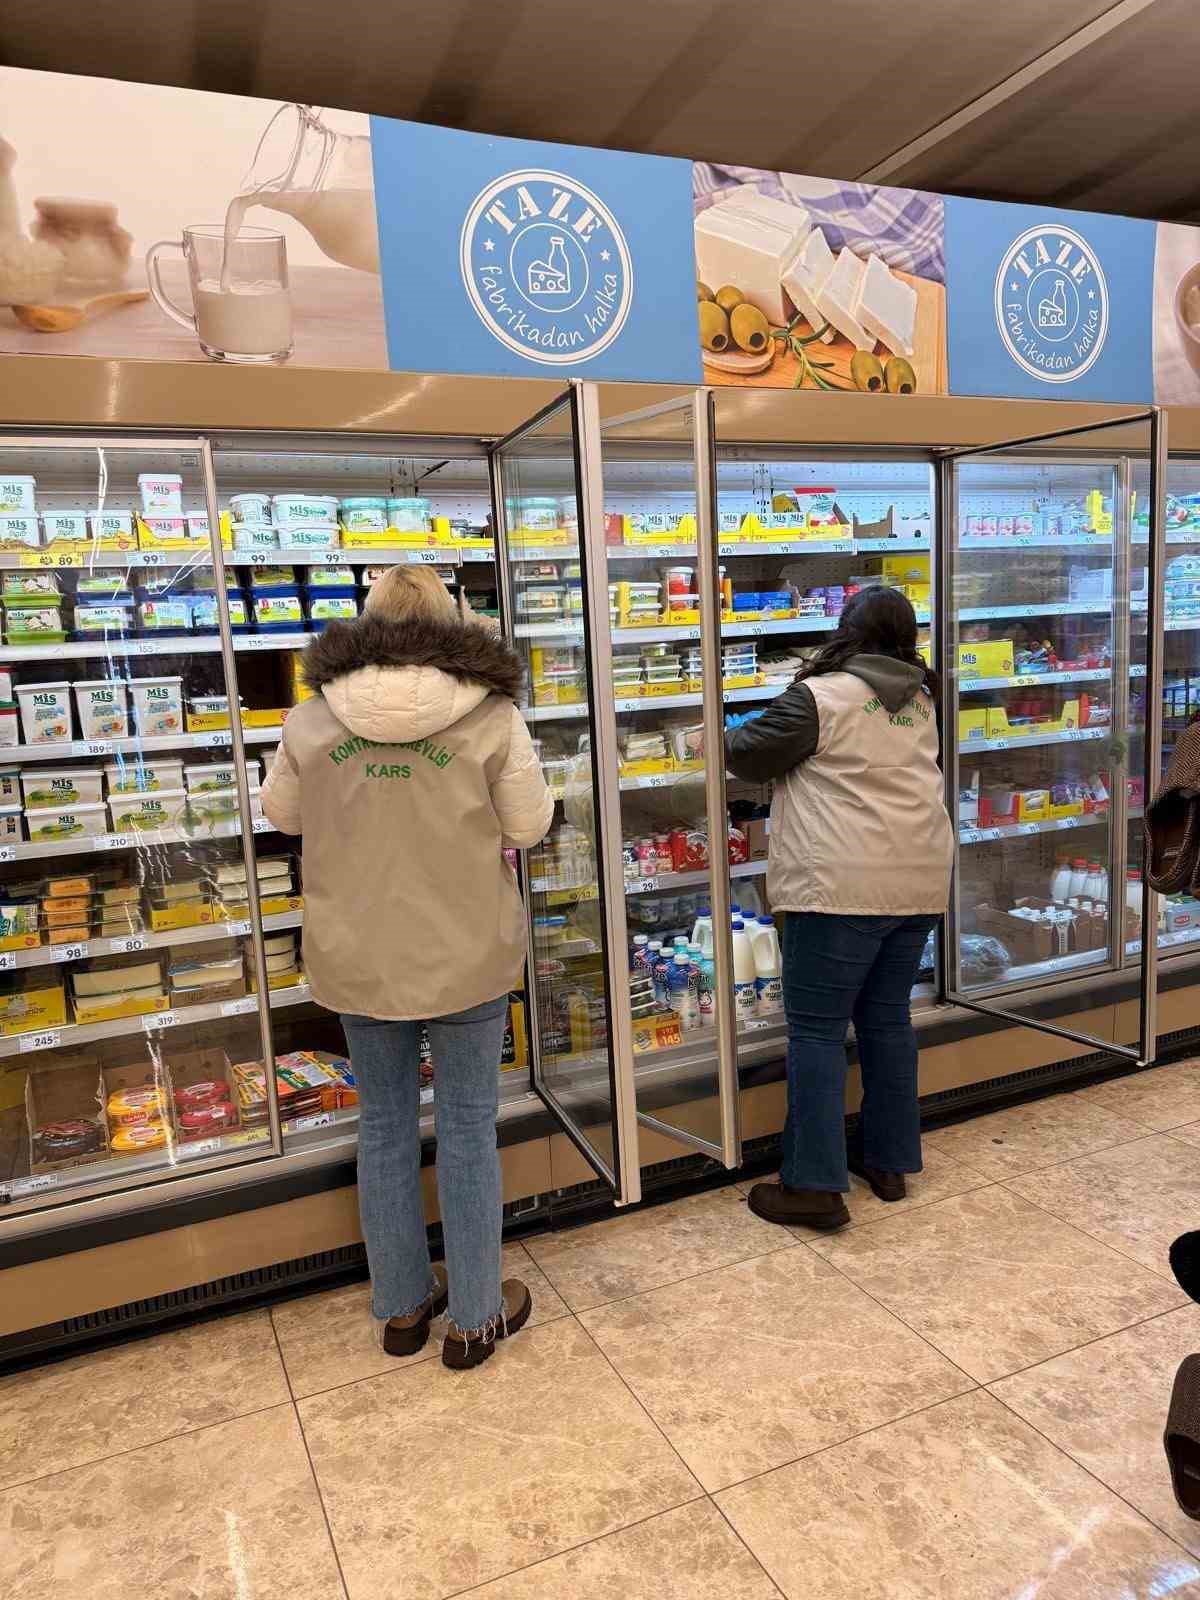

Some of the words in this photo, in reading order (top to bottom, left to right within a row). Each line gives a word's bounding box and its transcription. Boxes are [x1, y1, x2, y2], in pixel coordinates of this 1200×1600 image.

[485, 186, 603, 243] TAZE
[1012, 238, 1092, 284] TAZE
[479, 265, 585, 348] fabrikadan
[584, 273, 617, 334] halka
[1006, 303, 1074, 369] fabrikadan
[1074, 309, 1099, 358] halka
[58, 556, 73, 566] 89
[143, 555, 158, 565] 99
[251, 554, 266, 563] 99
[326, 554, 340, 563] 99
[888, 713, 914, 728] KARS
[212, 736, 224, 744] 91
[88, 746, 105, 754] 189
[365, 763, 412, 778] KARS
[111, 838, 127, 847] 210
[642, 882, 653, 891] 29
[126, 940, 142, 951] 80
[66, 948, 81, 959] 98
[158, 1017, 173, 1026] 319
[34, 1037, 54, 1047] 245
[661, 1034, 682, 1047] 145
